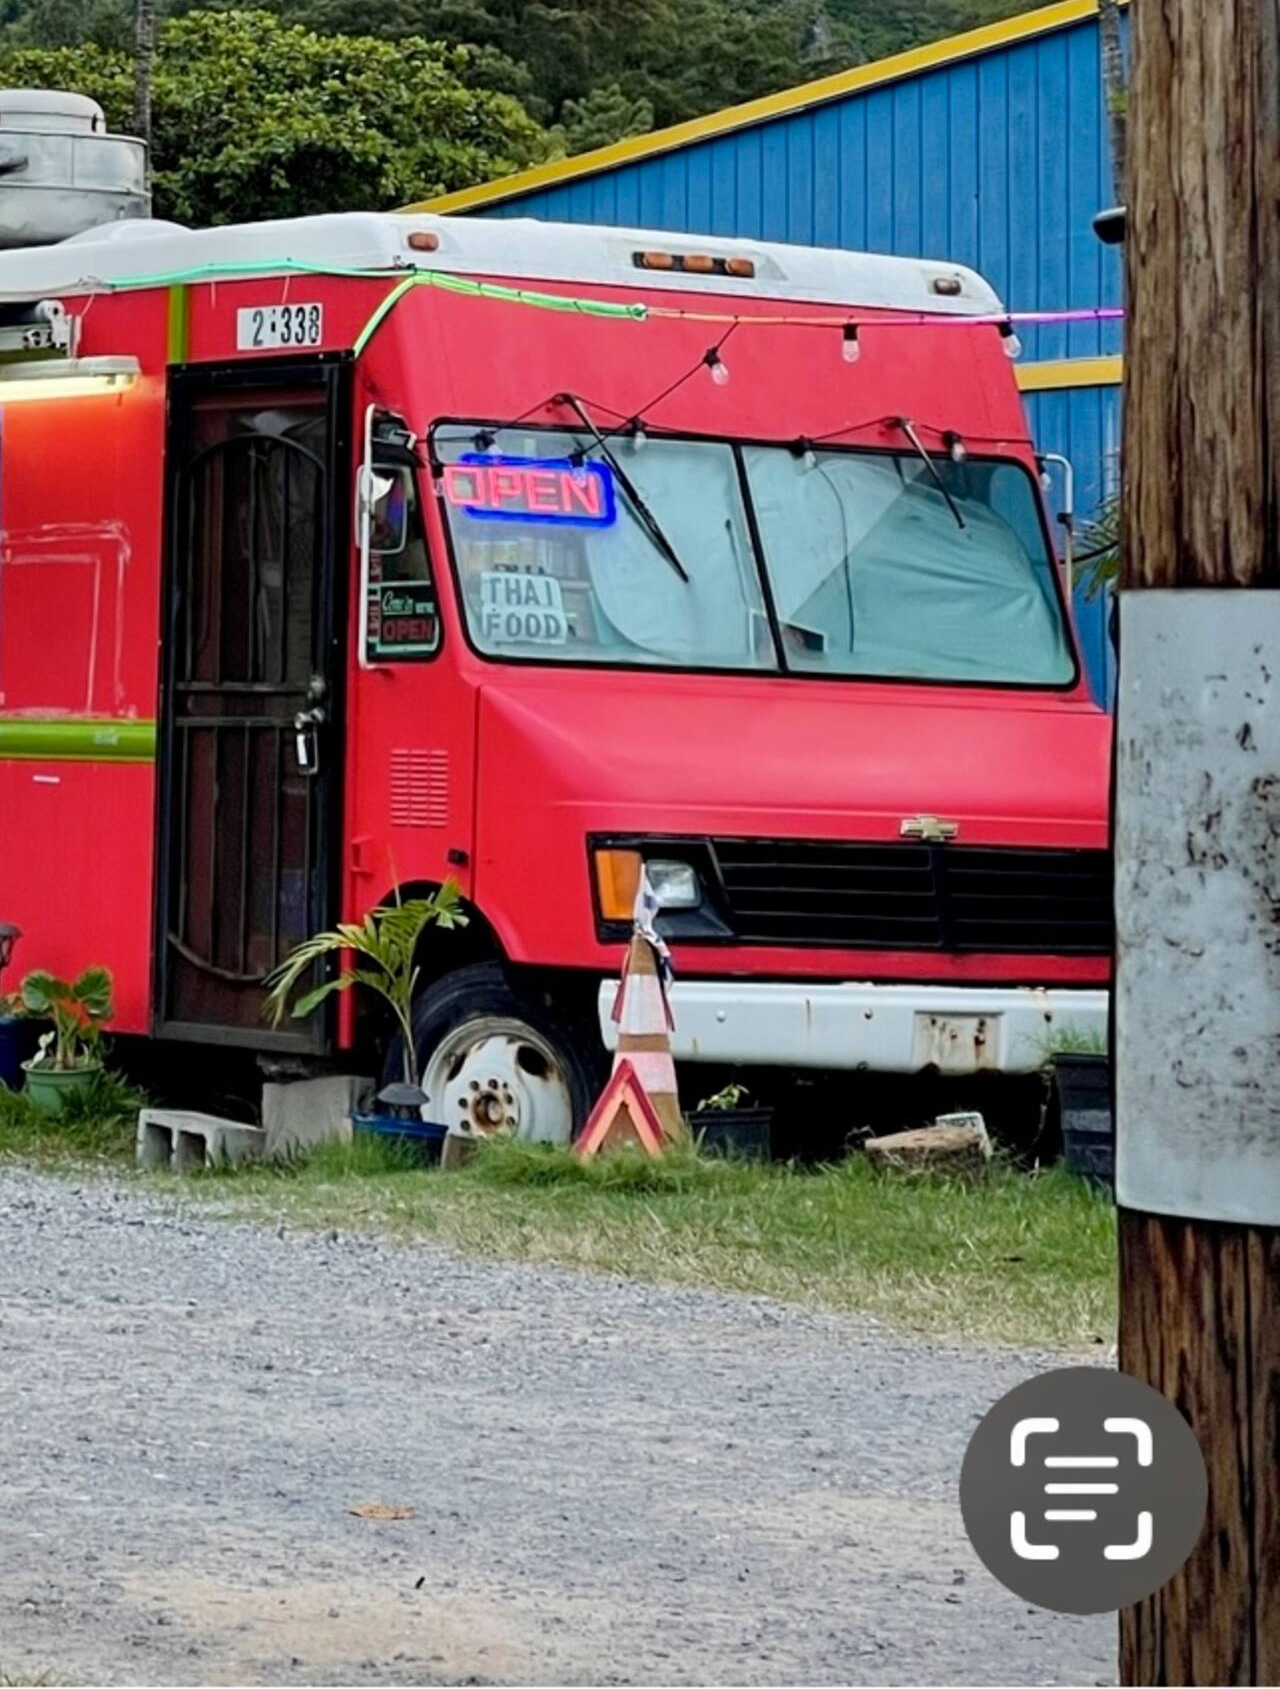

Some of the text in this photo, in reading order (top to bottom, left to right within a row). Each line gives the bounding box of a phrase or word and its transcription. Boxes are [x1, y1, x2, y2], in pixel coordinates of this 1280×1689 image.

[443, 466, 600, 514] OPEN
[489, 577, 552, 607] THAI
[383, 618, 433, 641] OPEN
[485, 613, 561, 640] FOOD
